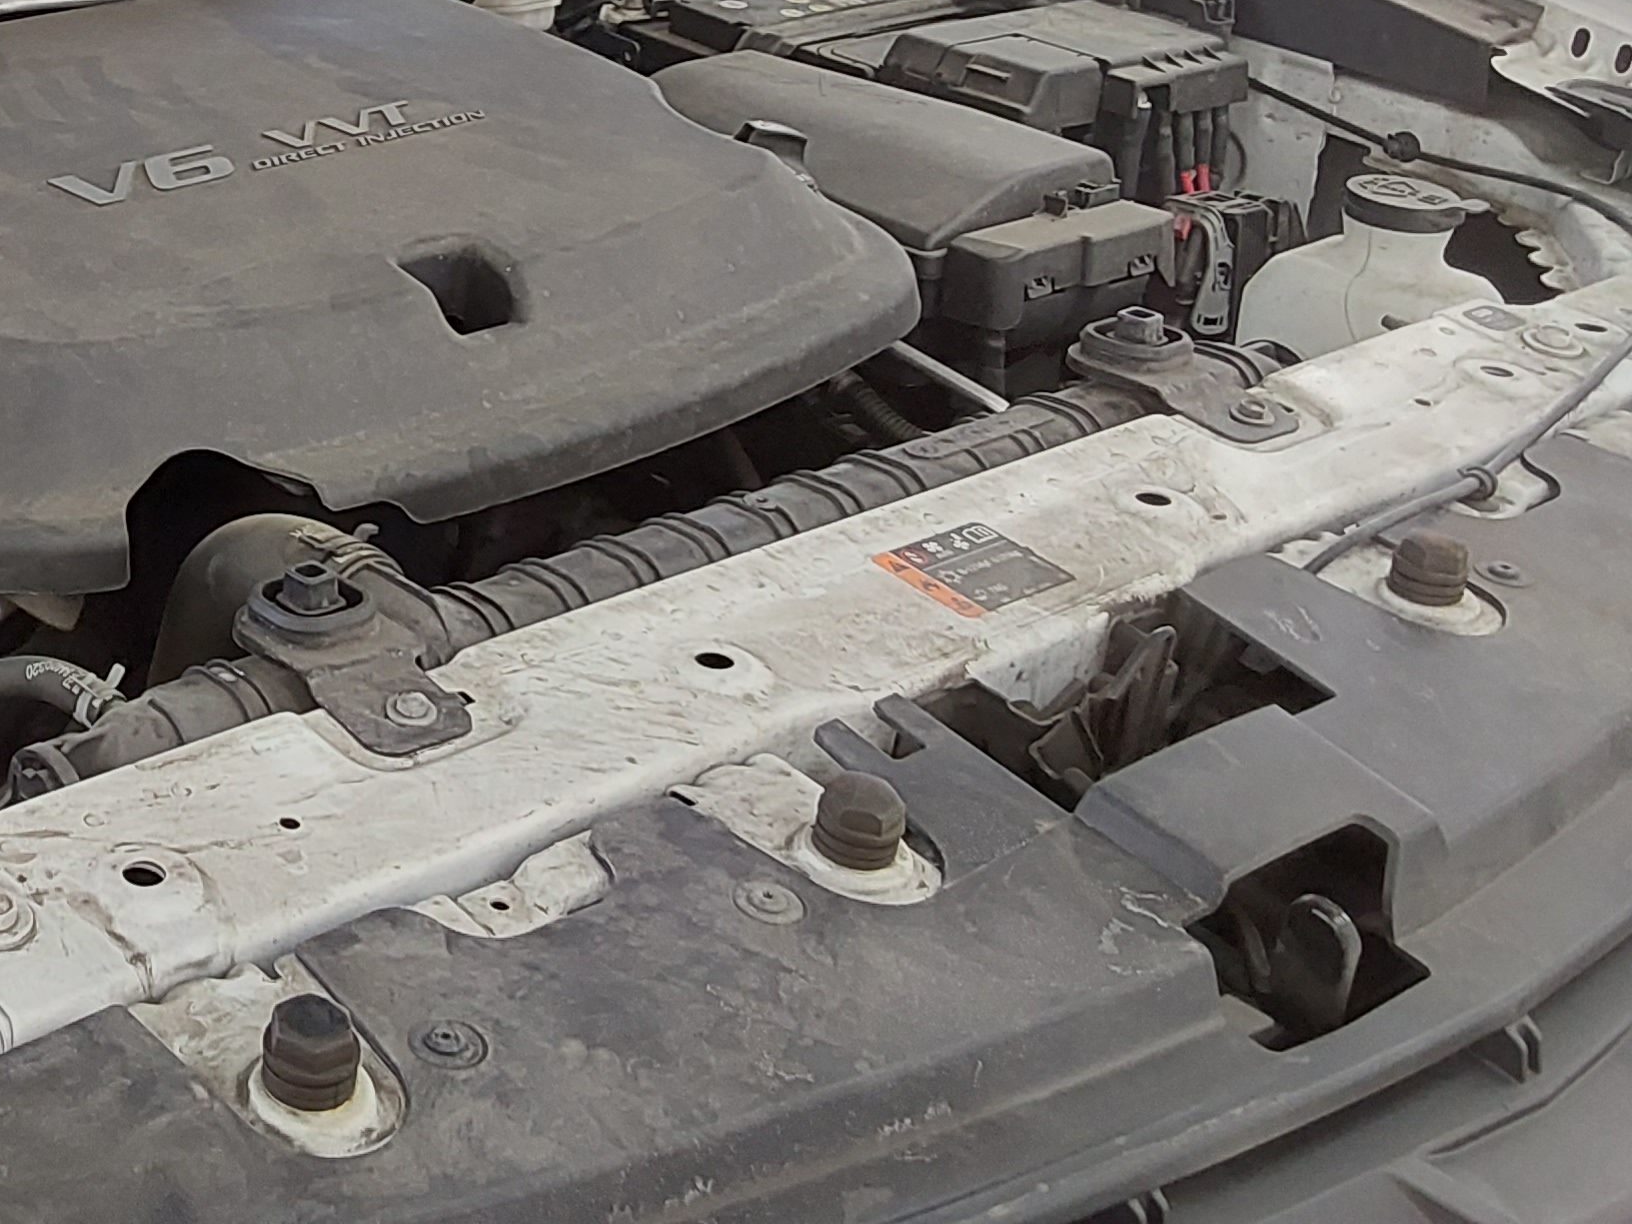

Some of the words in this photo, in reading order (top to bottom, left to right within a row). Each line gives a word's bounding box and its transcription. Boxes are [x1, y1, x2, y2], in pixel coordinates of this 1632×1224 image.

[47, 144, 236, 206] V6
[263, 100, 409, 149] VVT
[251, 140, 347, 172] DIRECT
[356, 108, 487, 146] INJECTION
